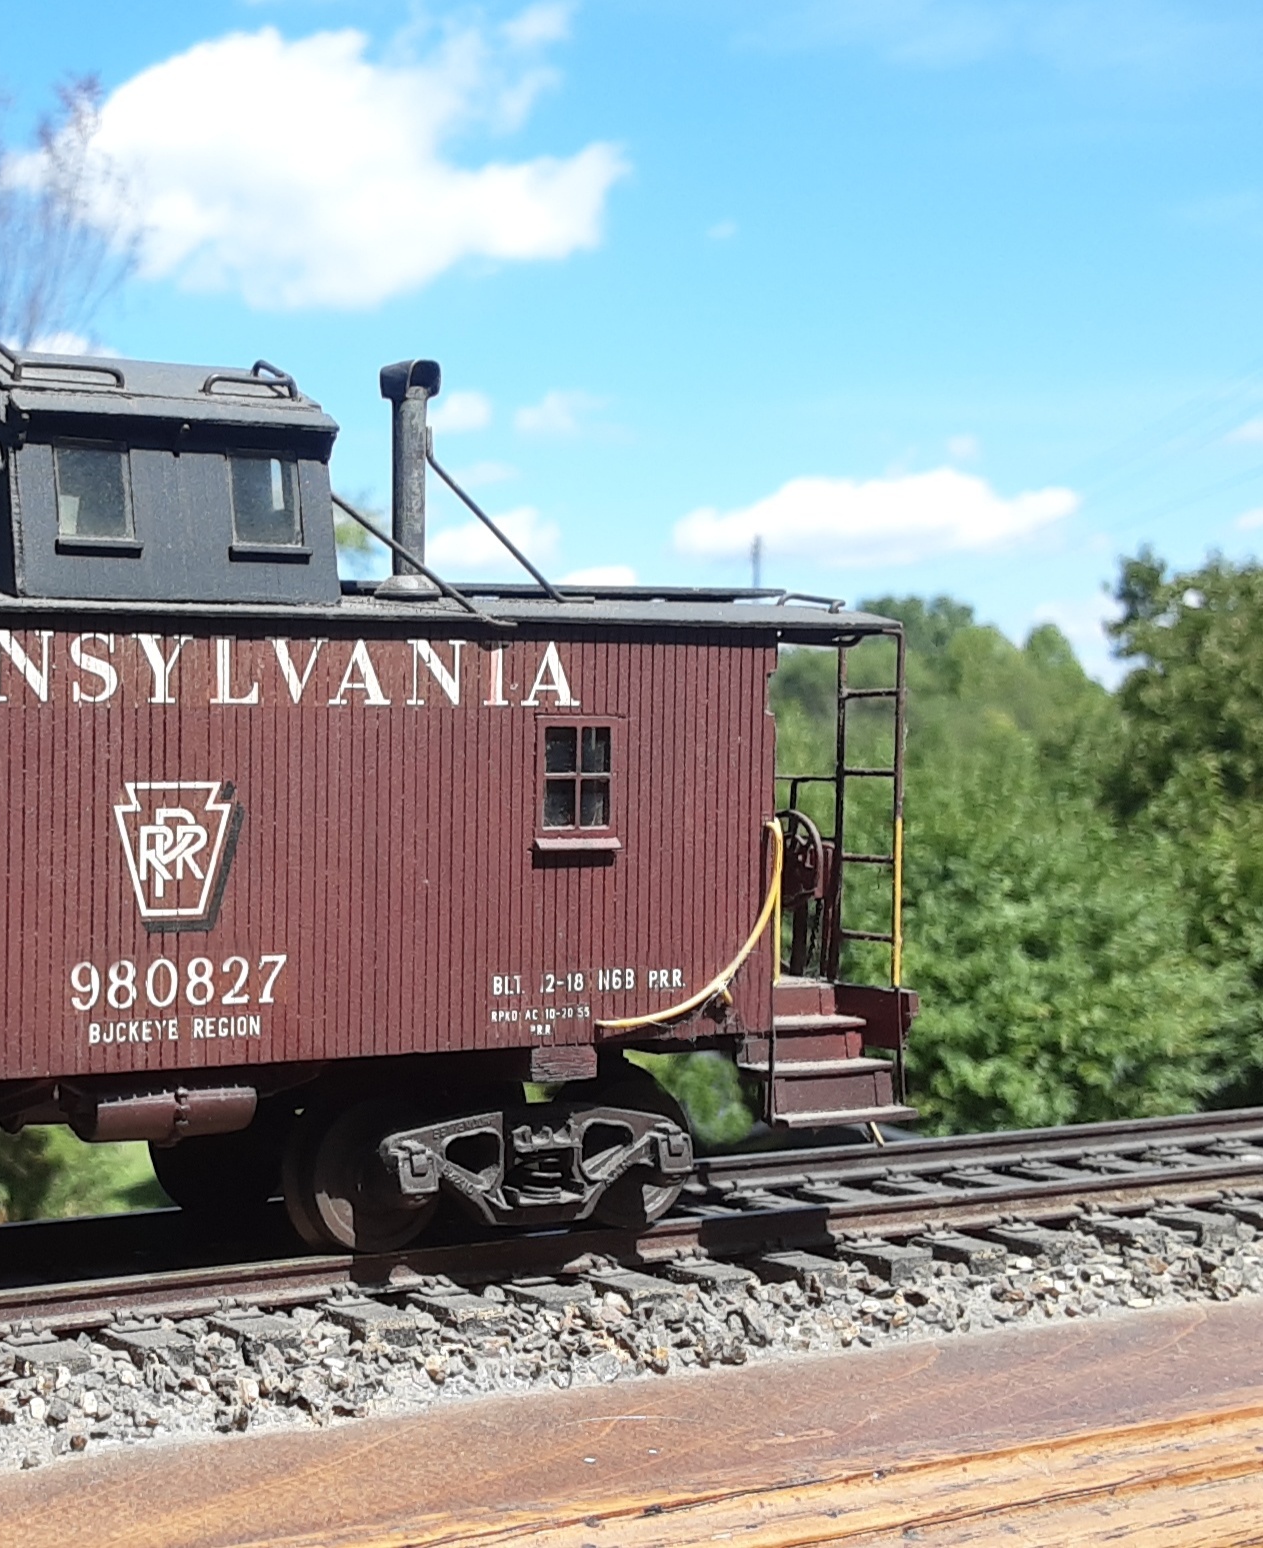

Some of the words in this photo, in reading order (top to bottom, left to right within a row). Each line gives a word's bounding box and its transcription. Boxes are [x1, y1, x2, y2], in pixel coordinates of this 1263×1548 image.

[70, 953, 288, 1012] 980827
[598, 968, 635, 991] N6B
[524, 1008, 539, 1020] AC
[88, 1017, 179, 1044] BUCKEYE
[193, 1014, 260, 1039] REGION
